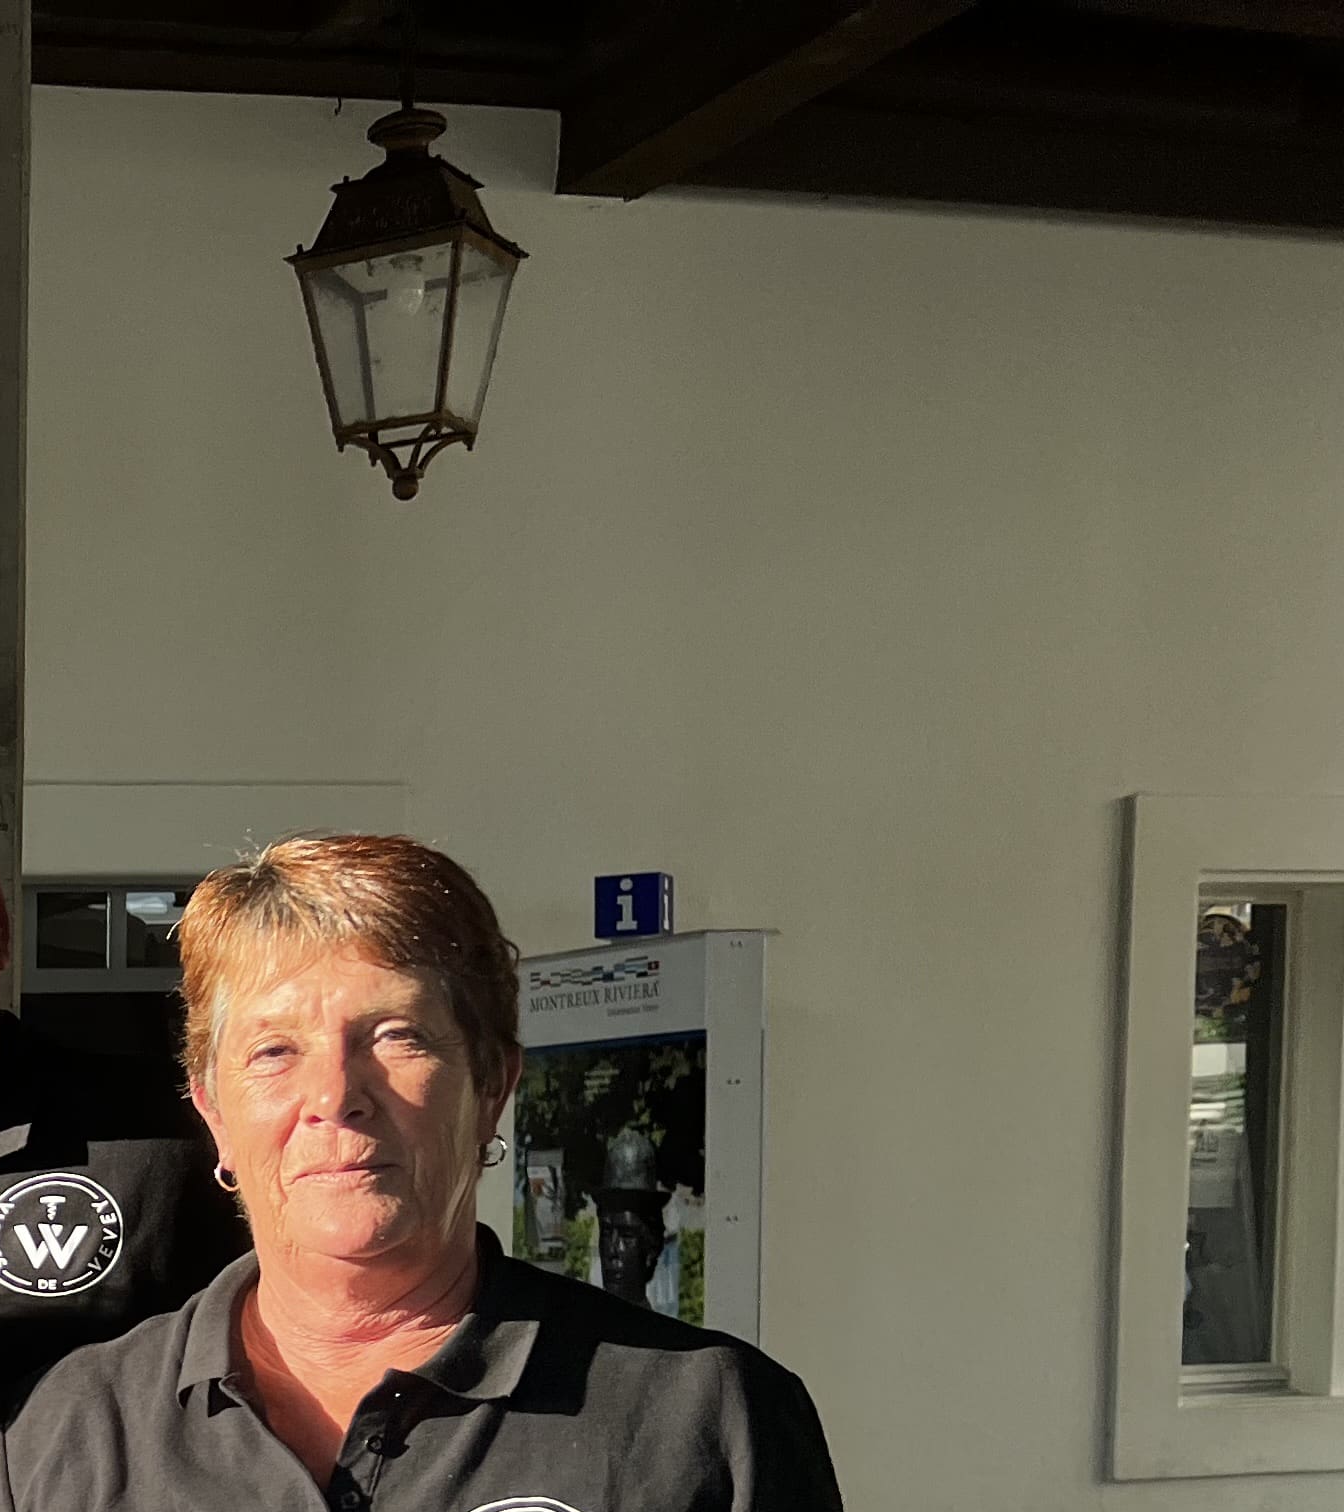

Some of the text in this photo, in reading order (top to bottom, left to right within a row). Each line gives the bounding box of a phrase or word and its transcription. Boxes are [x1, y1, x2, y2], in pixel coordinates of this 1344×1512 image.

[529, 989, 601, 1014] MONTREUX
[603, 980, 659, 1005] RIVIERA
[37, 1278, 58, 1290] DE
[87, 1200, 118, 1272] VEVEY
